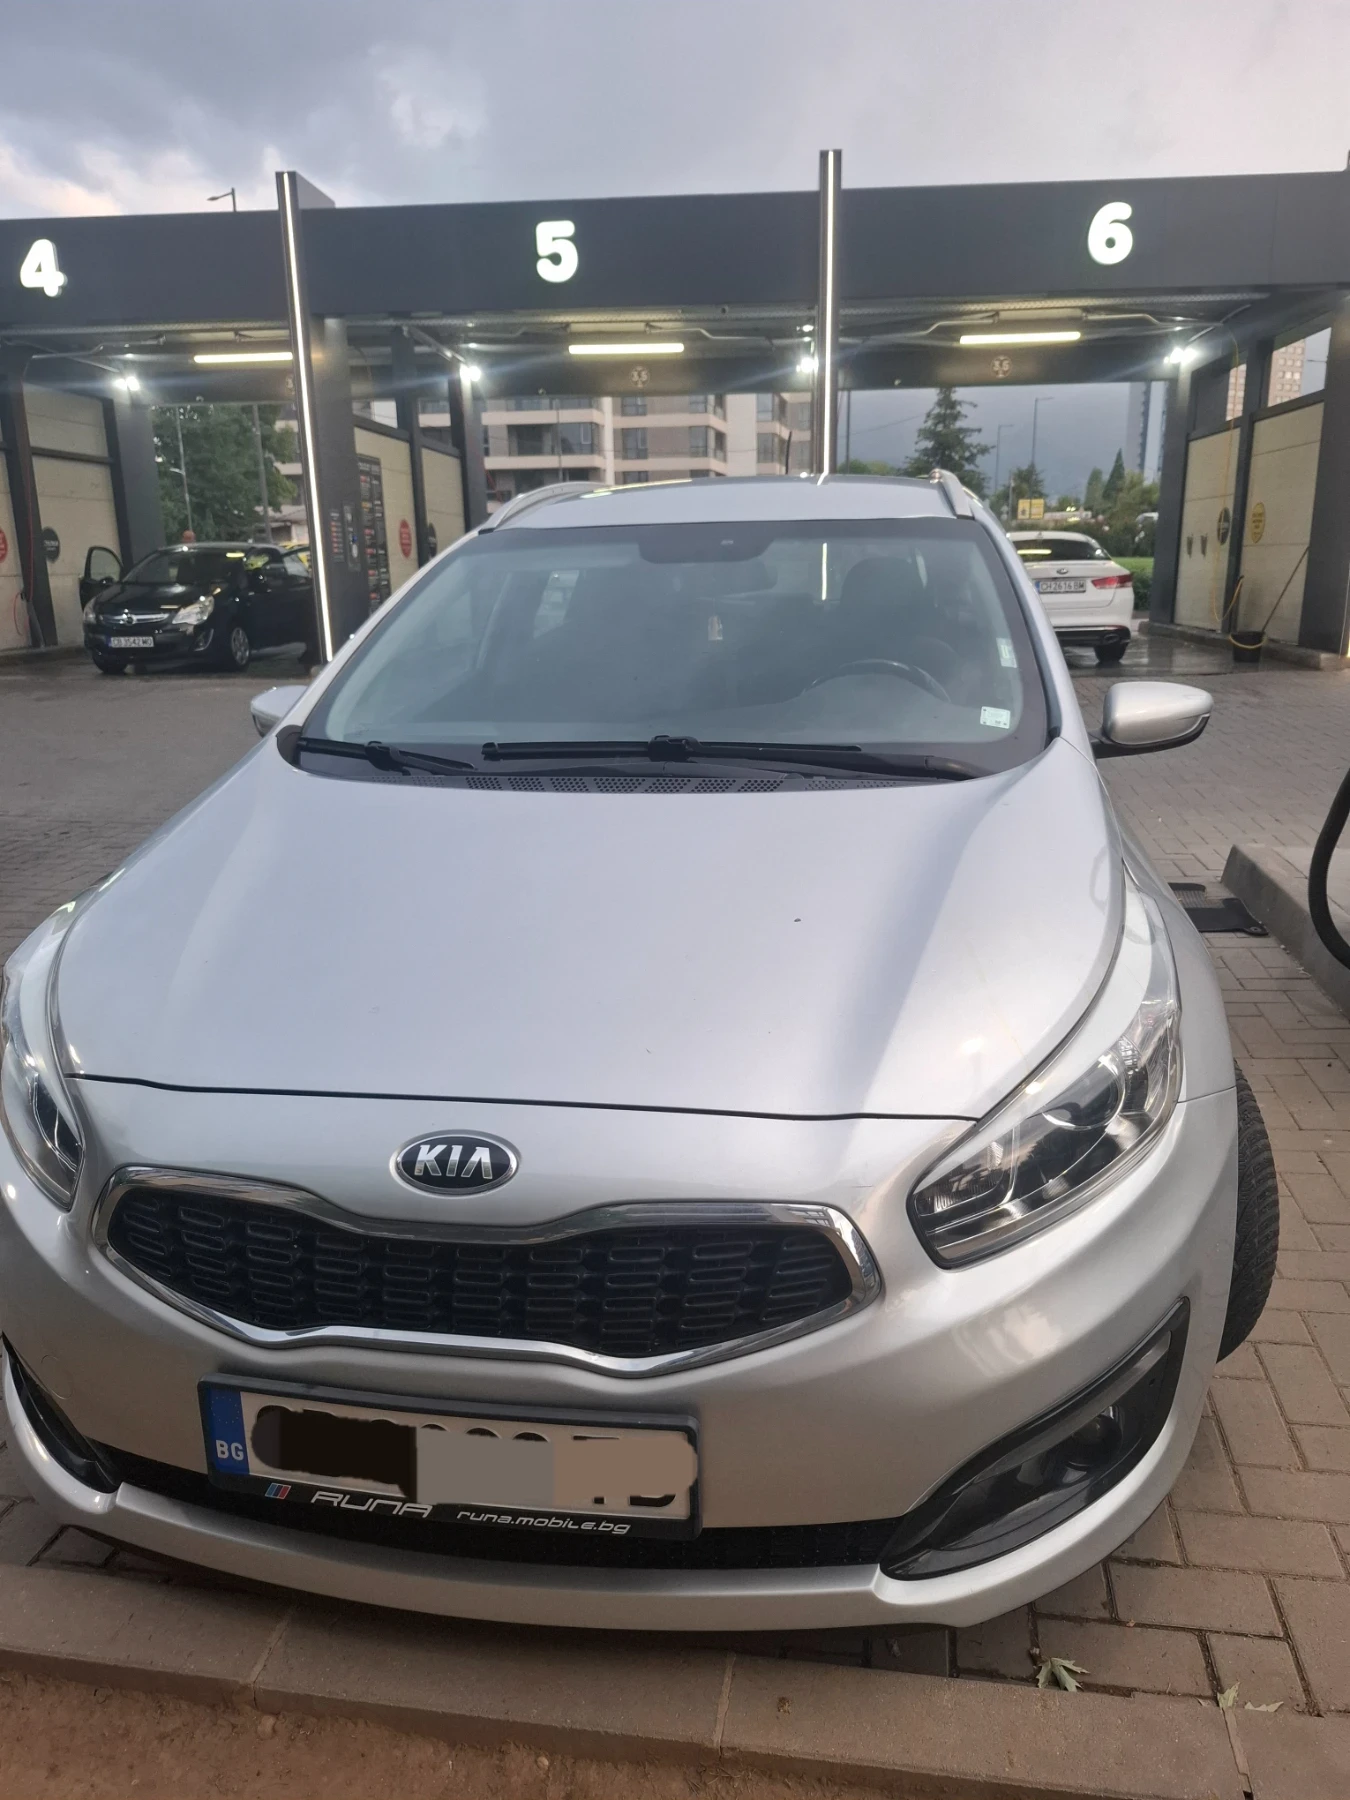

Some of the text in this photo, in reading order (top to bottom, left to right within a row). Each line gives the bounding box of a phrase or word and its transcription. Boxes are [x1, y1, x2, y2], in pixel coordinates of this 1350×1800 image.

[536, 220, 578, 282] 5
[1087, 202, 1133, 265] 6
[20, 239, 67, 296] 4
[414, 1144, 493, 1179] KIA
[215, 1439, 245, 1461] BG
[311, 1490, 632, 1535] RUNA runa.mobile.bg
